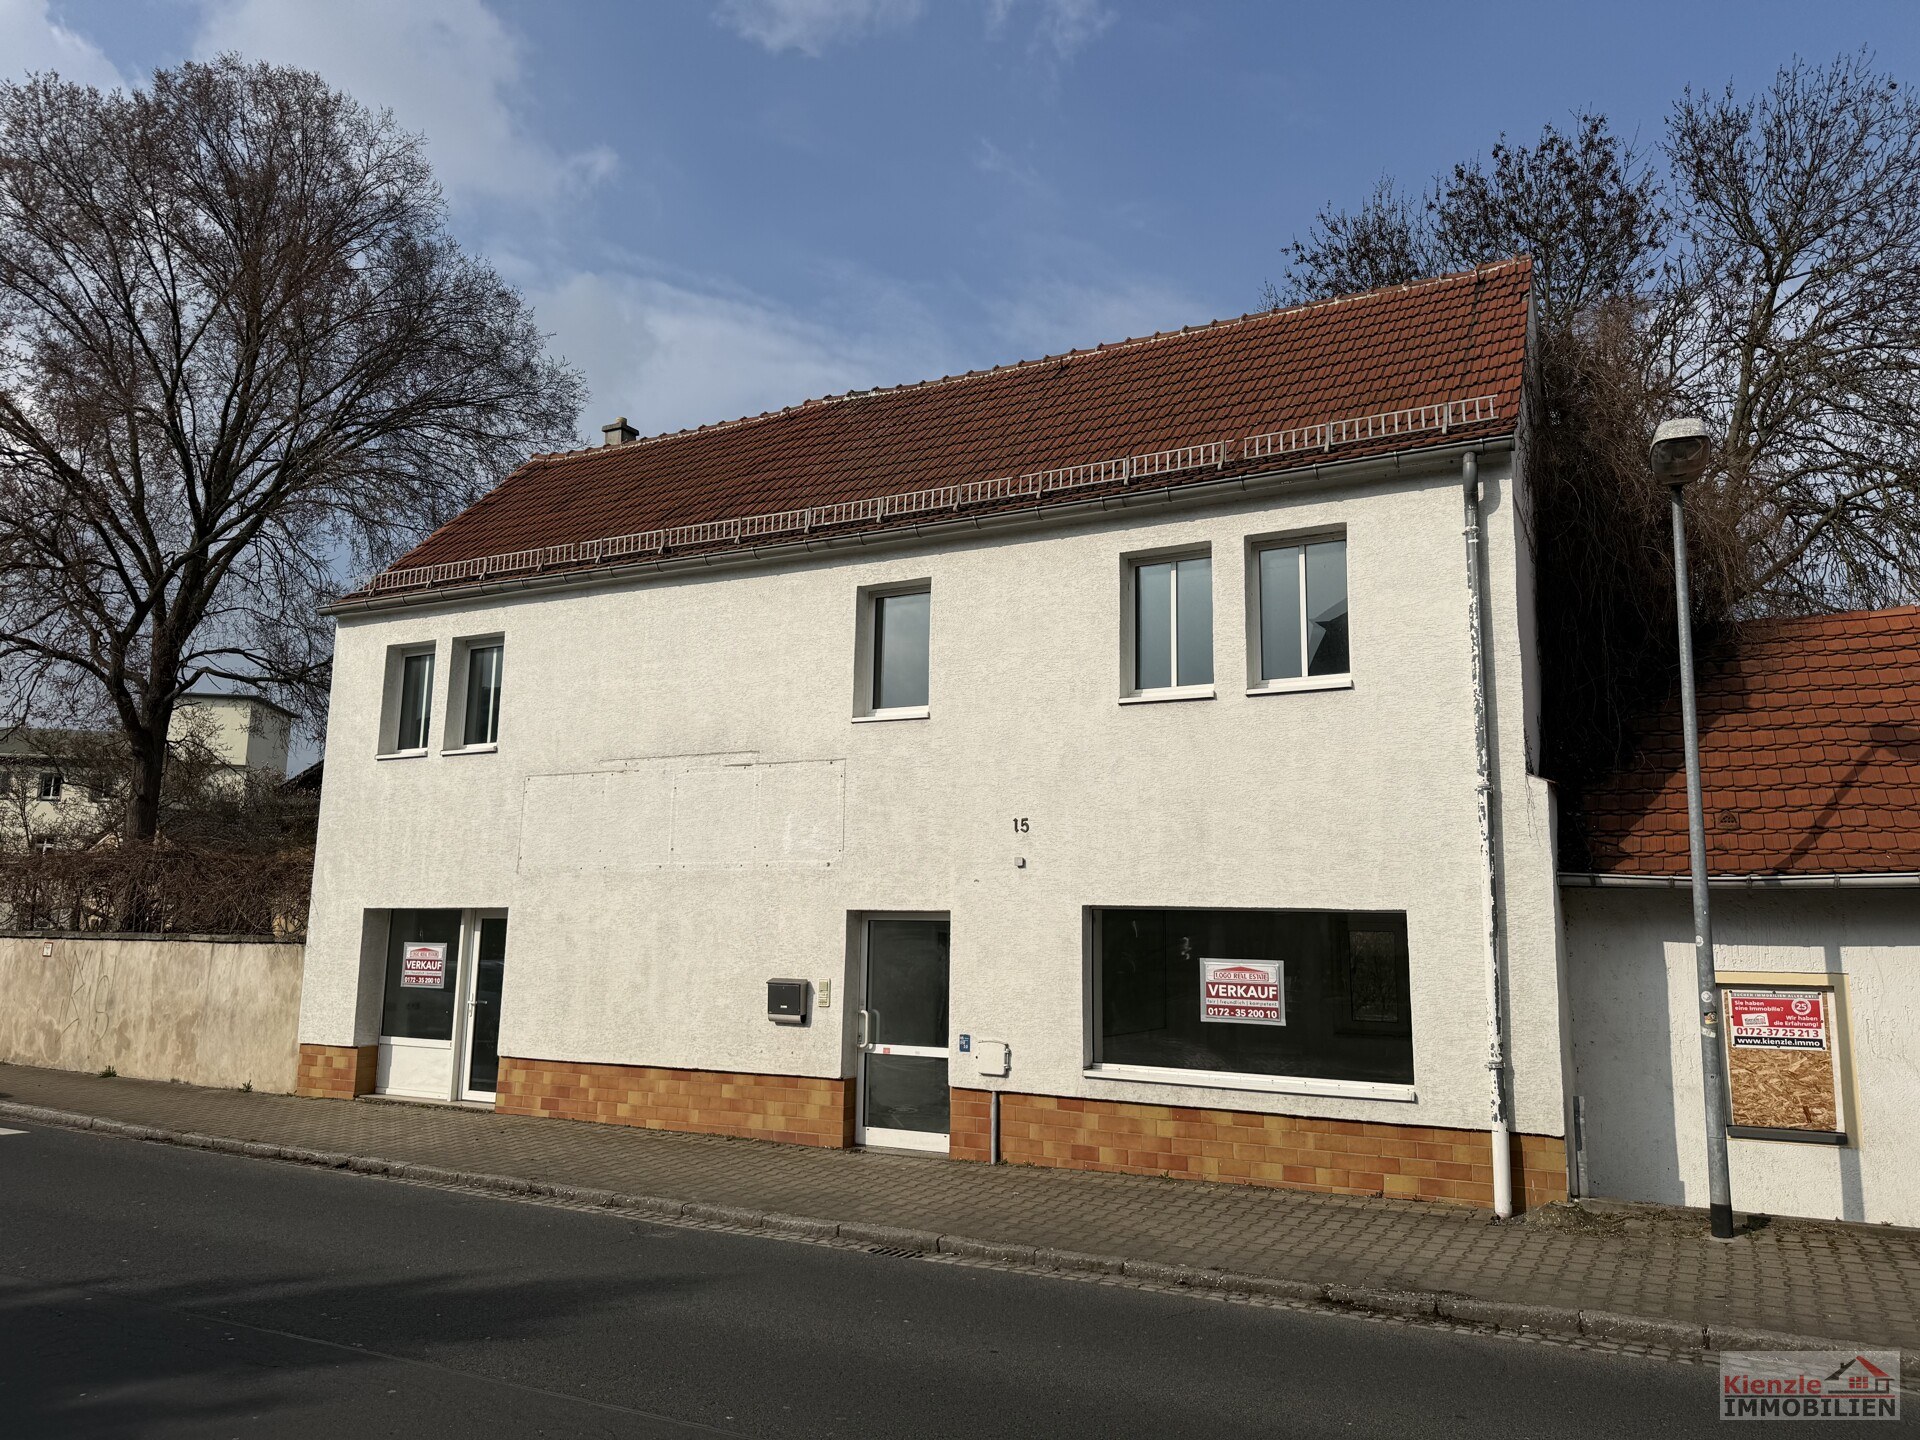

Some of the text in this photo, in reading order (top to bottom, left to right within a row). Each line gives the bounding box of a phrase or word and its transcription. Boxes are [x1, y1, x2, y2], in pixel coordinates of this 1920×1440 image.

[1012, 818, 1029, 833] 15
[406, 960, 442, 970] VERKAUF
[1208, 984, 1277, 999] VERKAUF
[1208, 1007, 1230, 1016] 0172
[1236, 1008, 1246, 1017] 35
[1248, 1009, 1264, 1018] 200
[1737, 1027, 1779, 1036] 0172-37
[1737, 1038, 1820, 1047] www.kienzle.immo
